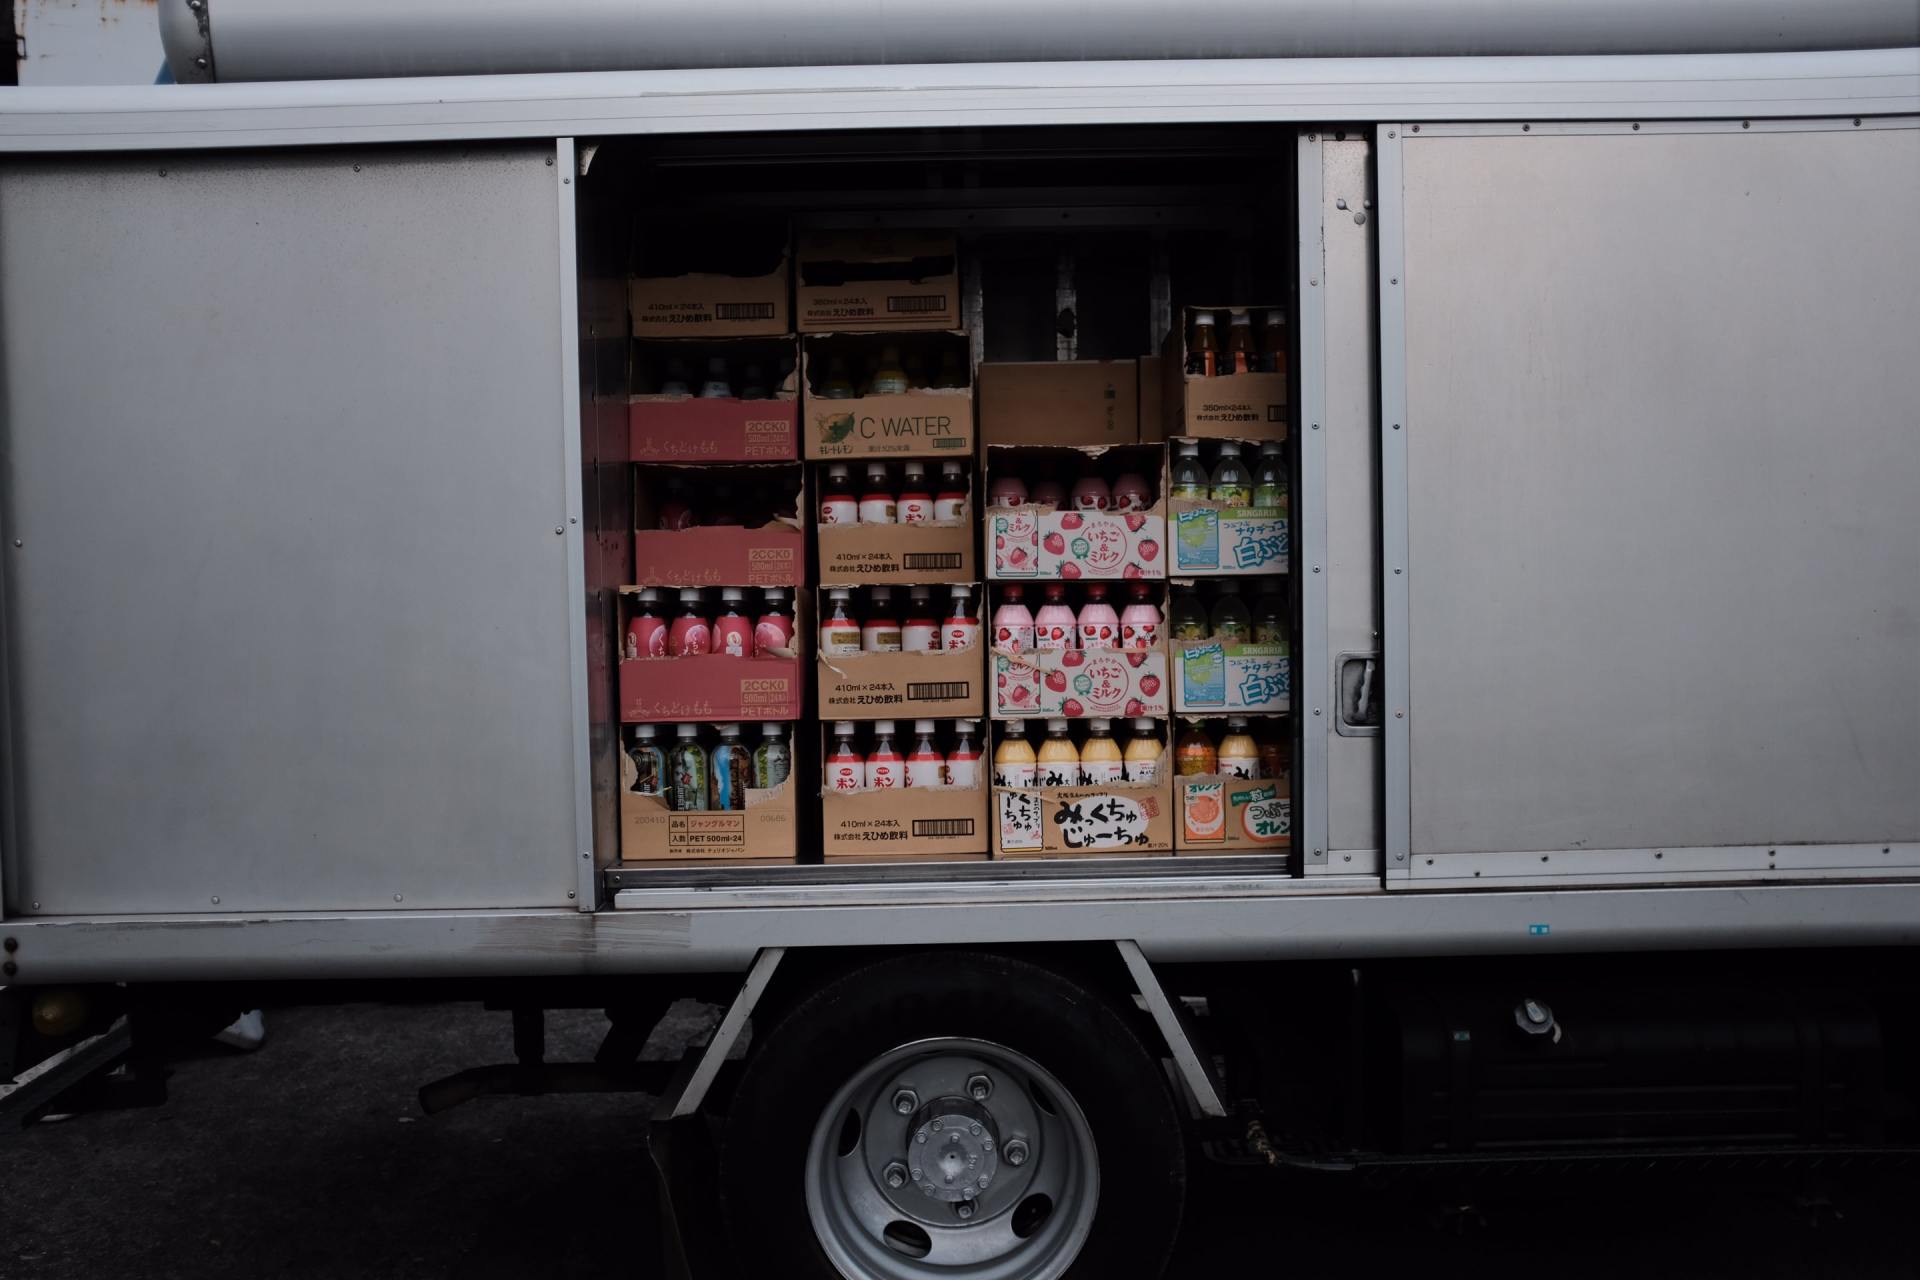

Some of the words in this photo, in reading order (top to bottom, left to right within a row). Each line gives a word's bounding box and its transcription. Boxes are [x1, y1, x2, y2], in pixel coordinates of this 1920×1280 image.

[860, 417, 875, 439] C
[881, 416, 951, 437] WATER
[1088, 531, 1120, 543] いちご
[1091, 552, 1119, 562] ミルク
[1242, 646, 1283, 655] SANGARIA
[1090, 667, 1121, 679] いちご
[1102, 680, 1111, 688] &
[1093, 688, 1121, 699] ミルク
[829, 694, 903, 705] 株式会社えひめ飲料
[1054, 798, 1137, 825] みっくちゅ
[671, 820, 686, 828] 品名
[690, 820, 740, 828] ジャングルマン
[834, 831, 908, 841] 株式会社えひめ飲料
[1064, 826, 1149, 848] じゅーちゅ
